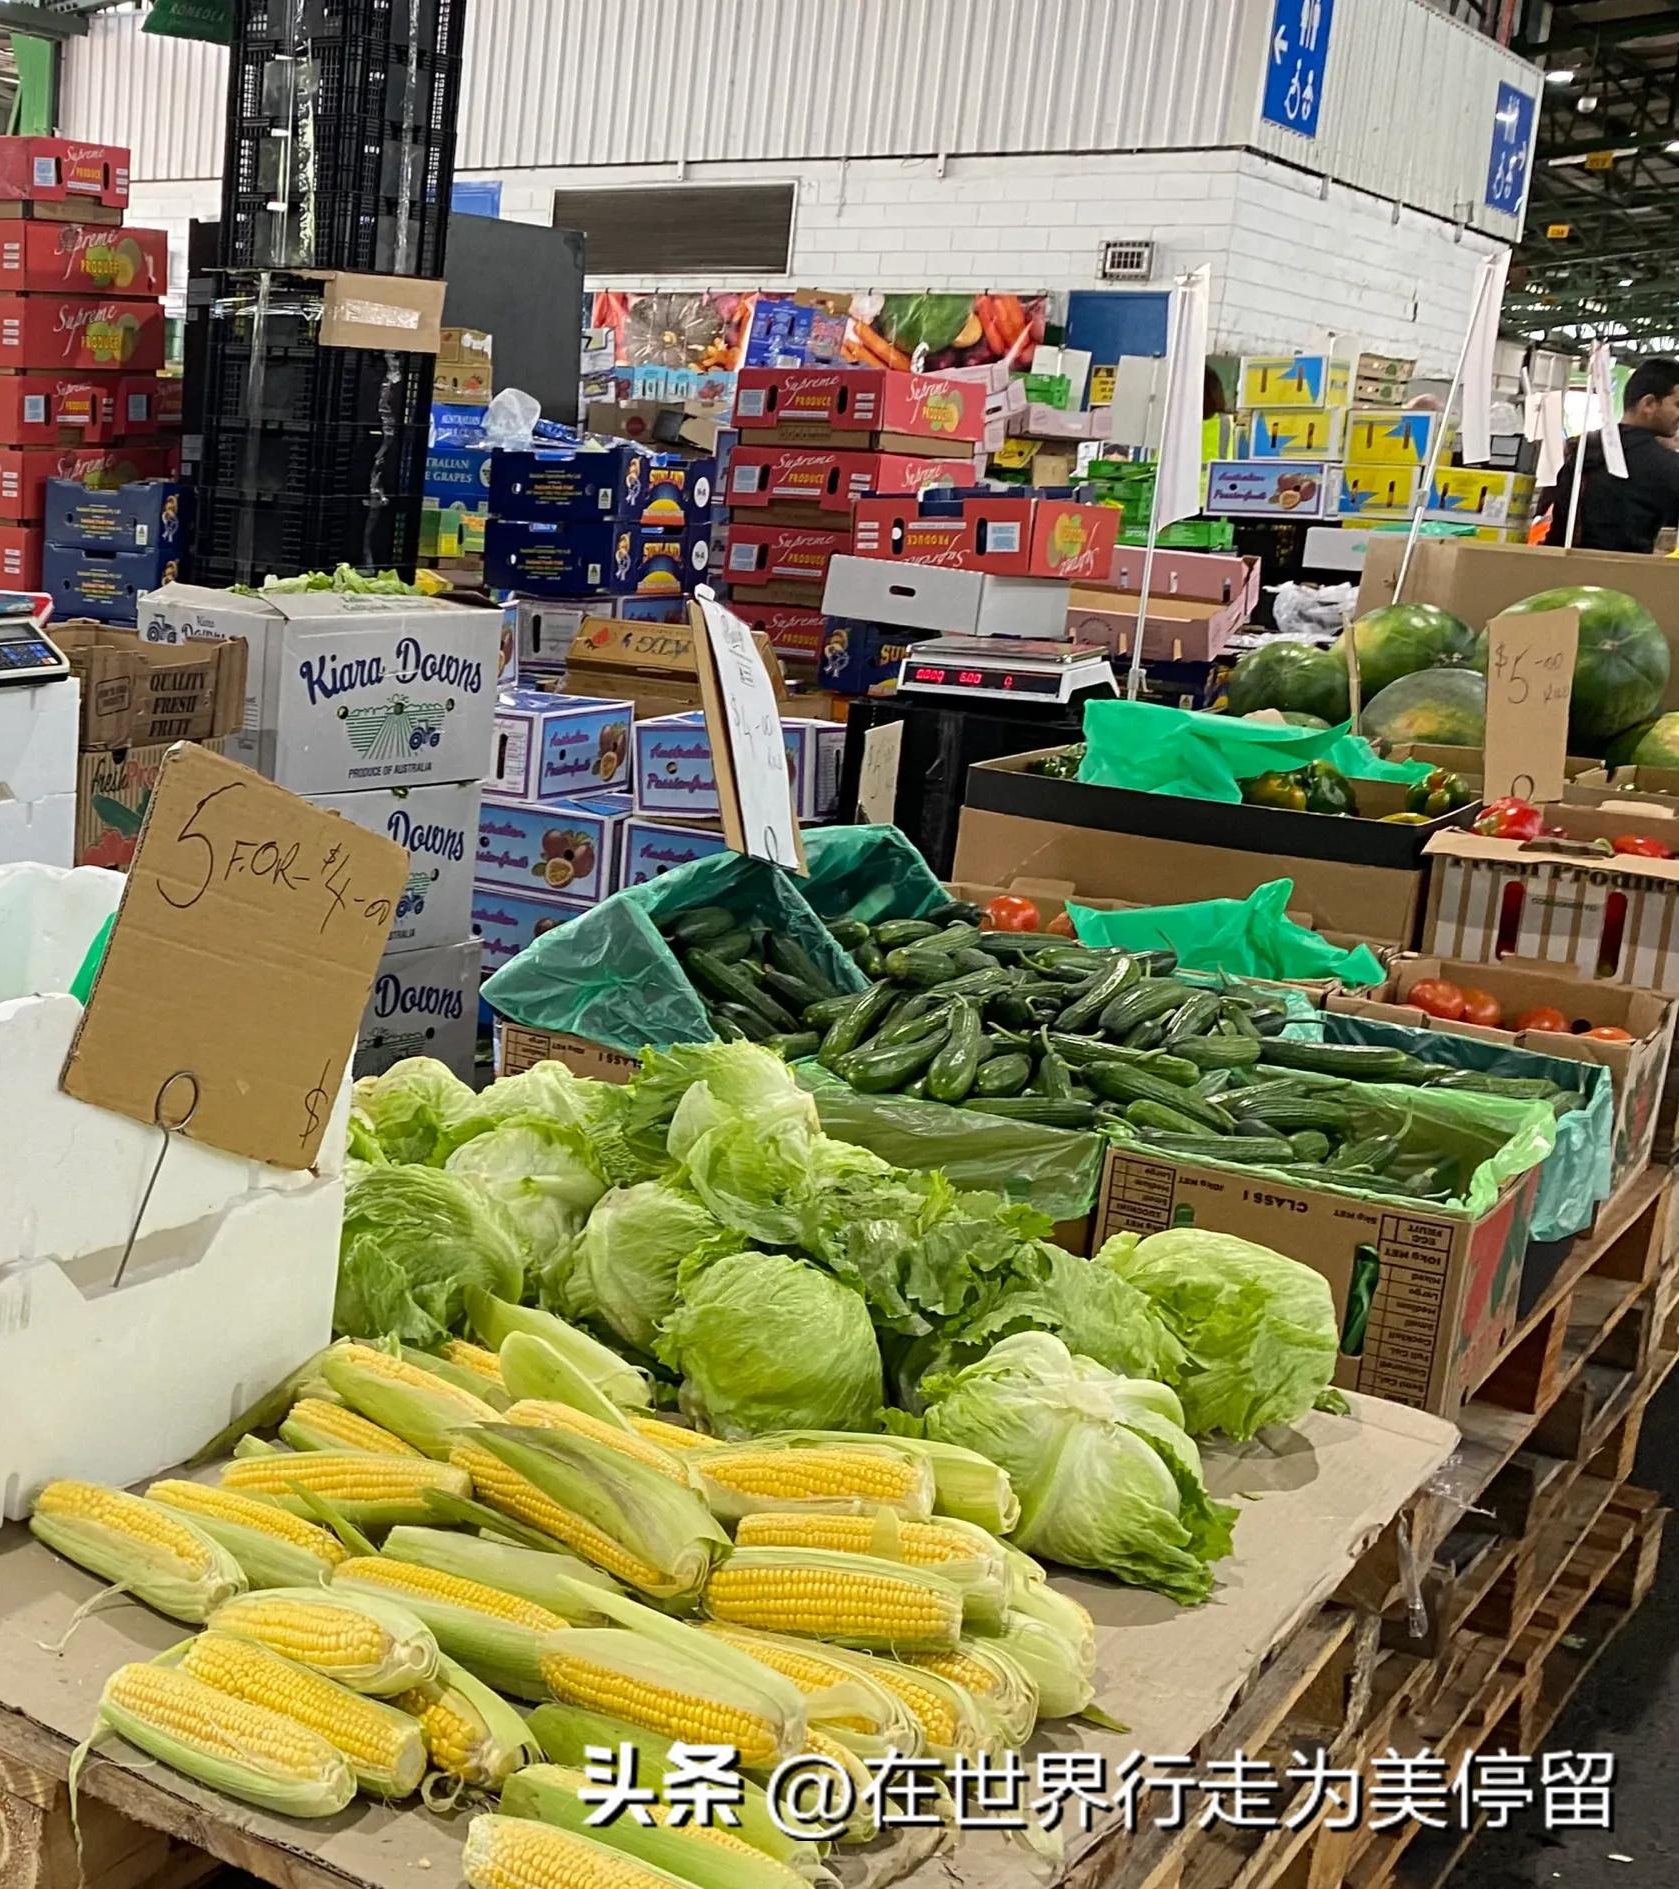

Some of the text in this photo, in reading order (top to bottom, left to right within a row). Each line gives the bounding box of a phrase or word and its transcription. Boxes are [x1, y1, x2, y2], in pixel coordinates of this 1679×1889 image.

[64, 146, 105, 177] Supreme
[54, 305, 118, 357] Supreme
[81, 335, 120, 349] PRODUCE
[778, 376, 840, 406] Supreme
[795, 396, 832, 406] PRODUCE
[906, 378, 949, 424] Supreme
[426, 457, 470, 469] TRALIAN
[773, 453, 837, 483] Supreme
[432, 471, 472, 483] GRAPES
[788, 472, 824, 484] PRODUCE
[772, 533, 836, 562] Supreme
[906, 533, 950, 547] PRODUCE
[787, 554, 825, 565] PRODUCE
[767, 613, 828, 642] Supreme
[783, 634, 819, 645] PRODUCE
[300, 637, 482, 705] Kiara Downs
[149, 672, 207, 692] QUALITY
[152, 695, 198, 715] FRESH
[148, 719, 193, 738] FRUIT
[348, 761, 433, 779] PRODUCE OF AUSTRALIA
[387, 809, 465, 862] Downs
[375, 974, 464, 1020] Downs
[1253, 1191, 1309, 1214] CLASS
[1407, 1224, 1443, 1238] FRUIT
[1411, 1235, 1436, 1246] EGG
[1384, 1248, 1441, 1266] 10kg NET
[1408, 1287, 1439, 1301] Large
[1396, 1301, 1437, 1315] Medium
[1388, 1331, 1432, 1347] Cocktail
